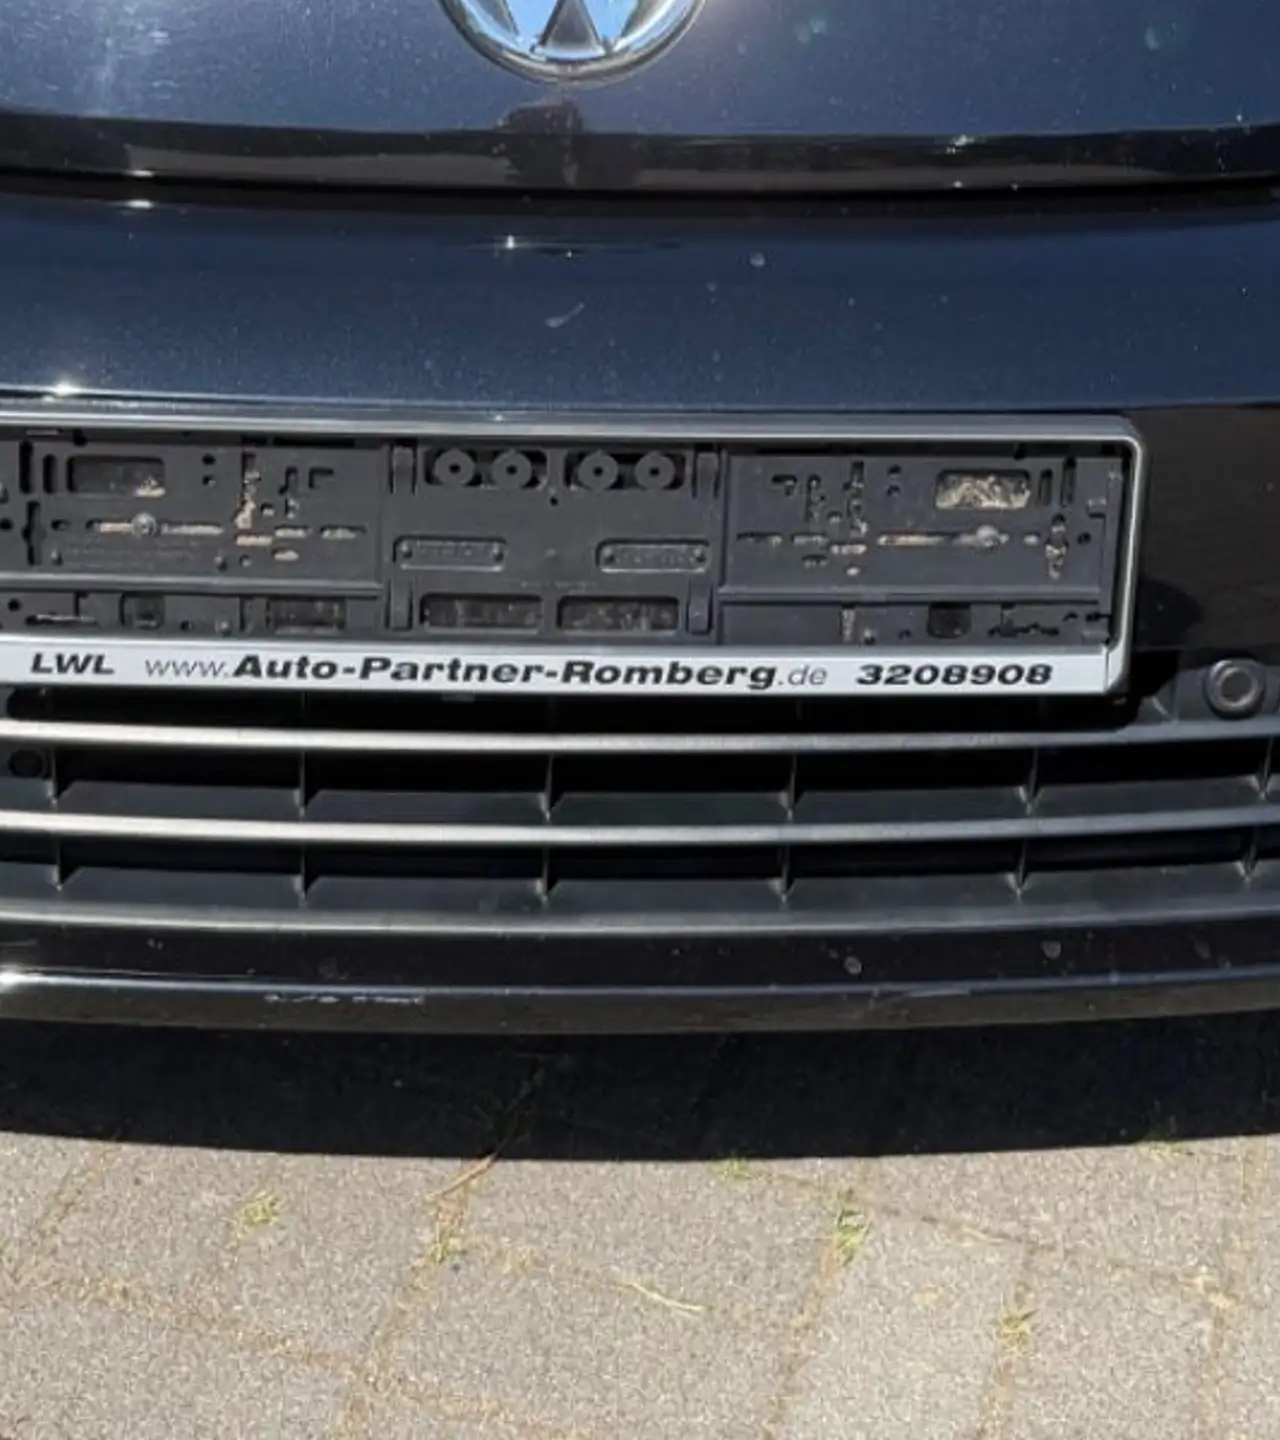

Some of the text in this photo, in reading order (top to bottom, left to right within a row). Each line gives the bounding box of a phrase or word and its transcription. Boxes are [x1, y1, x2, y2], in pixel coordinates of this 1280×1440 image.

[30, 652, 1053, 691] LWL www.Auto-Partner-Romberg.de 3208908
